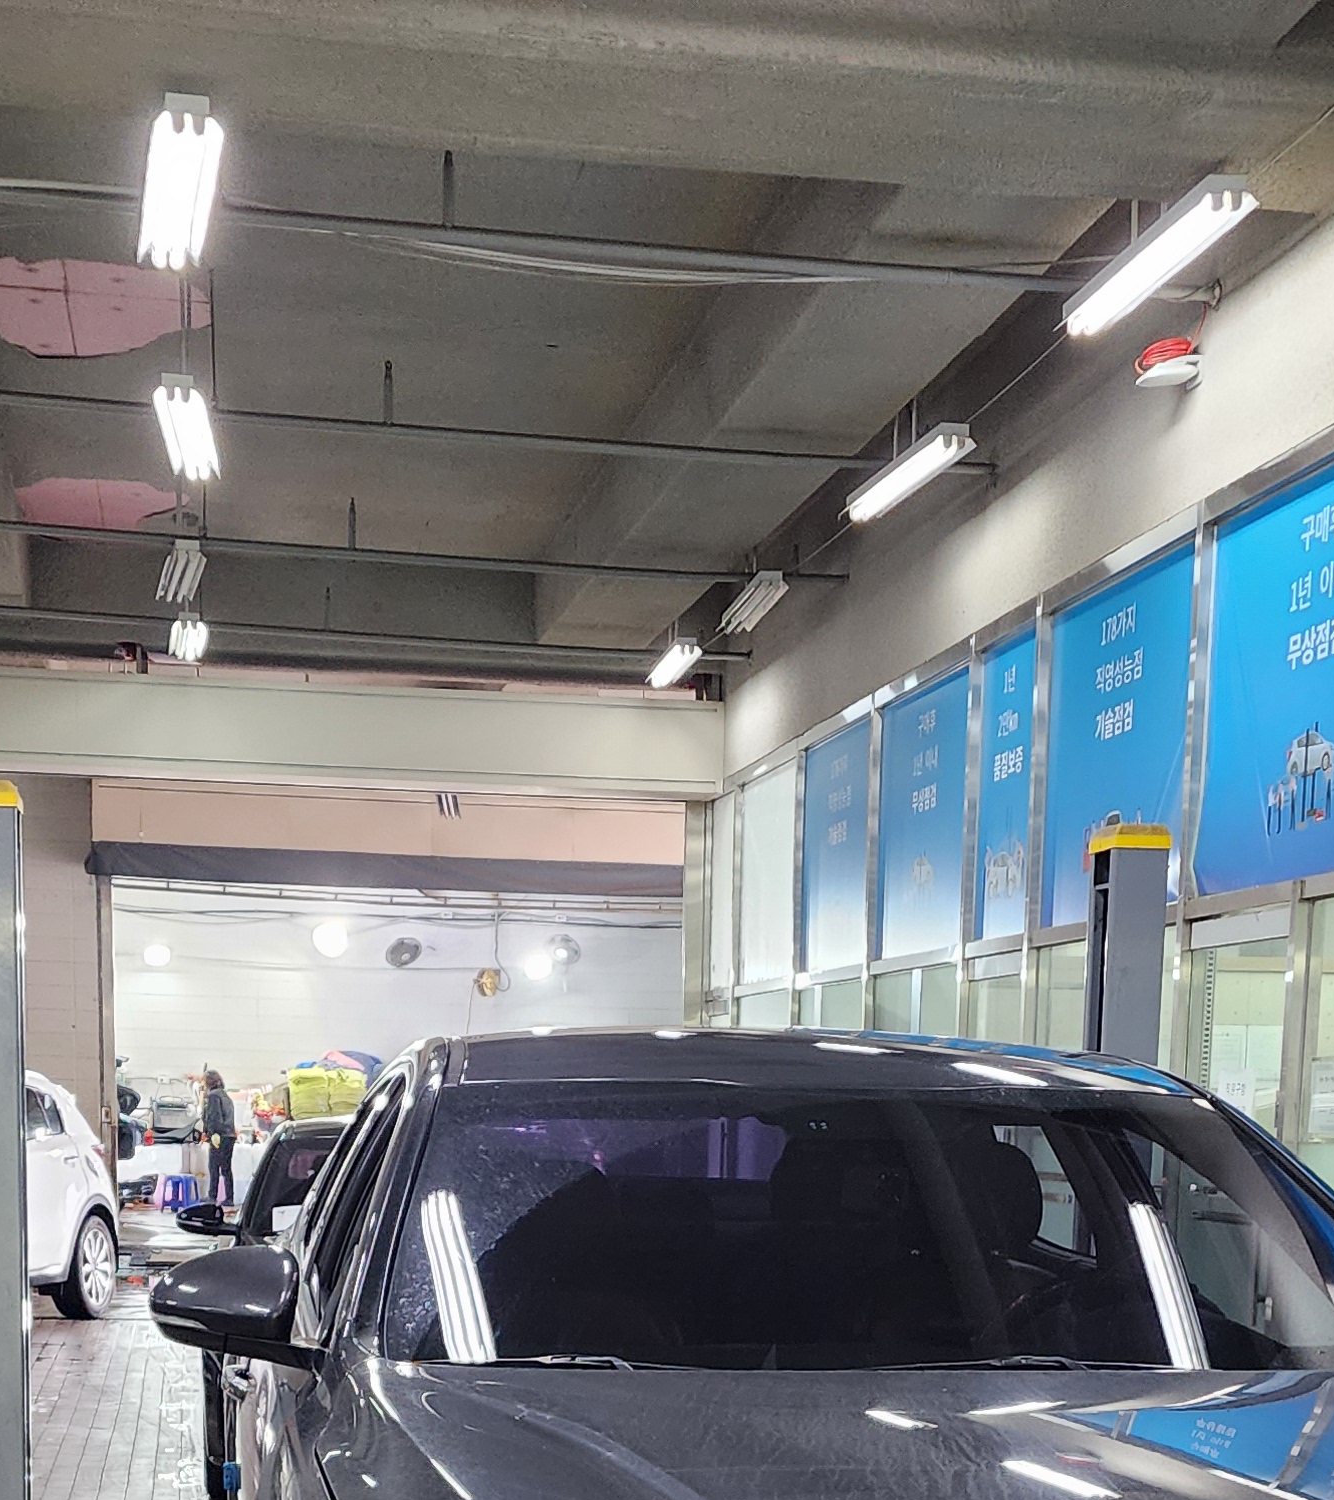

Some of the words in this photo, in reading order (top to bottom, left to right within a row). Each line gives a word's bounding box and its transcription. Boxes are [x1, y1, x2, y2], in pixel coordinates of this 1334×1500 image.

[1289, 570, 1312, 613] 1년
[1100, 601, 1137, 646] 178가지
[1002, 664, 1016, 694] 1년
[1095, 646, 1144, 694] 직영성능점
[1094, 698, 1134, 741] 기술점검
[993, 745, 1024, 782] 품질보증
